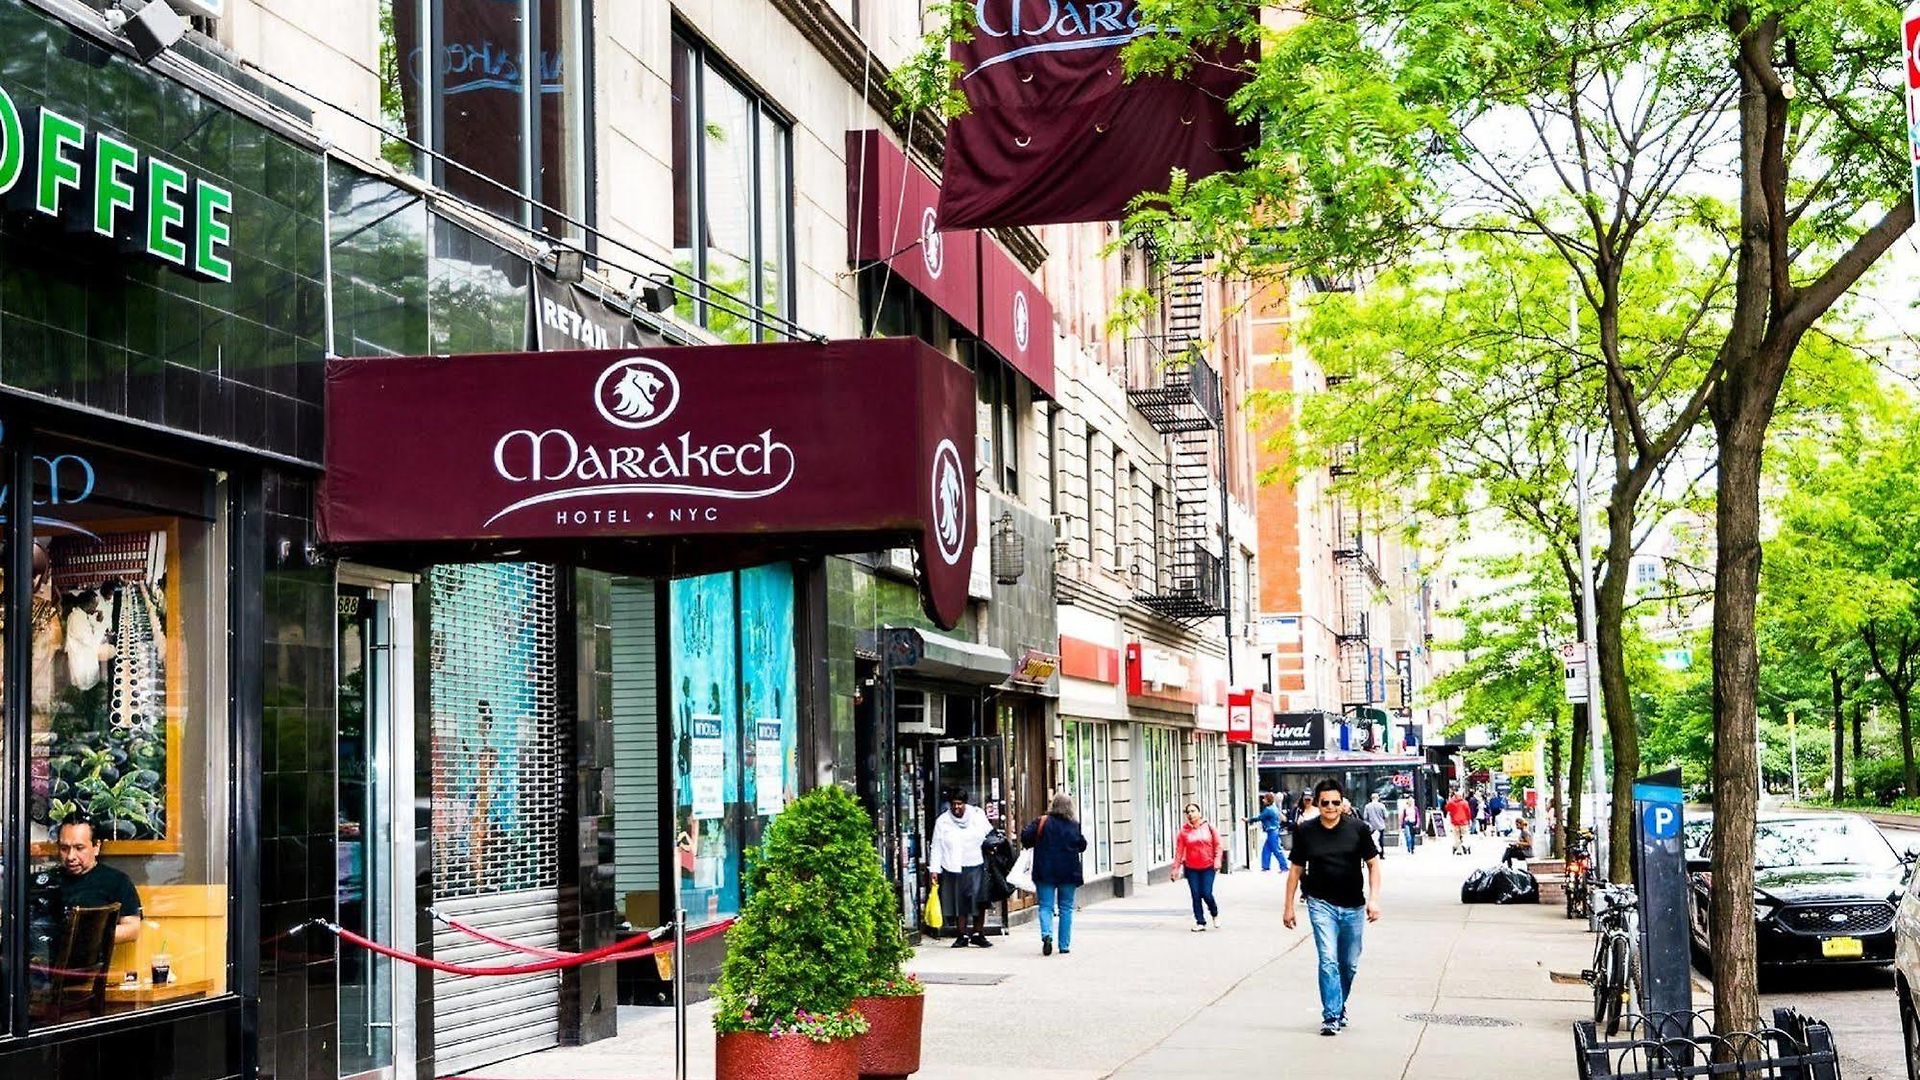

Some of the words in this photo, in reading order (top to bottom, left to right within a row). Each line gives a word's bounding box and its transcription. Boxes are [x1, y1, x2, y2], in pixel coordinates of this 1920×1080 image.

[543, 297, 610, 349] RETAIL
[494, 428, 795, 482] Marrakech
[557, 510, 631, 524] HOTEL
[670, 507, 718, 521] NYC
[338, 597, 357, 612] 688
[1655, 807, 1673, 834] P
